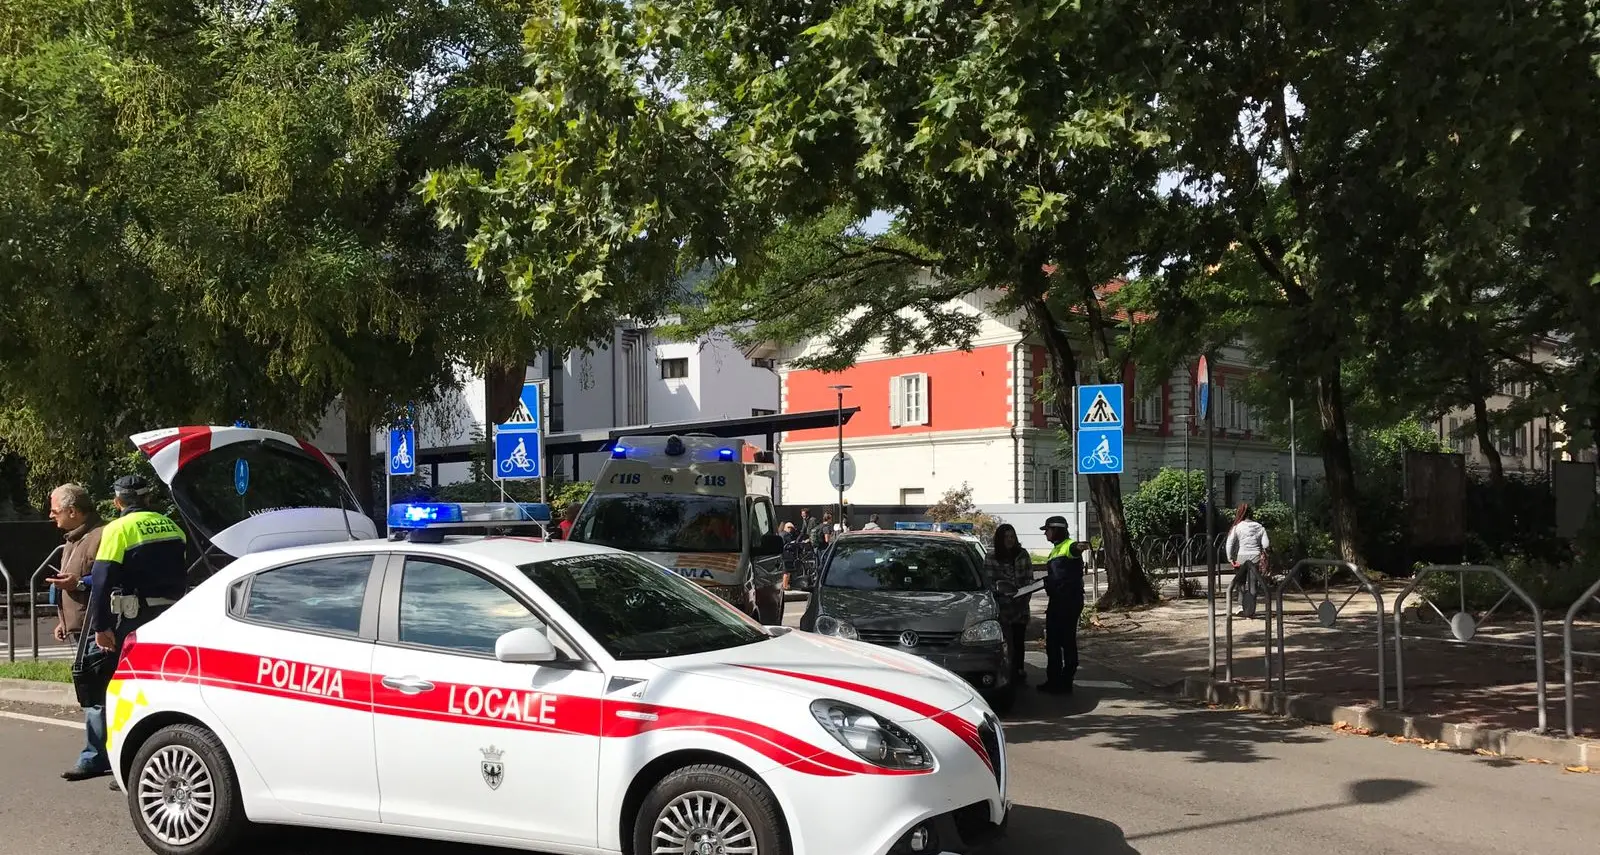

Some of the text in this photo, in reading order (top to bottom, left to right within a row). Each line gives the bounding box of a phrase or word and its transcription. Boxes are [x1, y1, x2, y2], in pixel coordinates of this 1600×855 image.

[619, 473, 641, 485] 118
[703, 475, 727, 487] 118
[140, 525, 178, 535] LOCALE
[256, 656, 344, 699] POLIZIA
[447, 684, 557, 725] LOCALE
